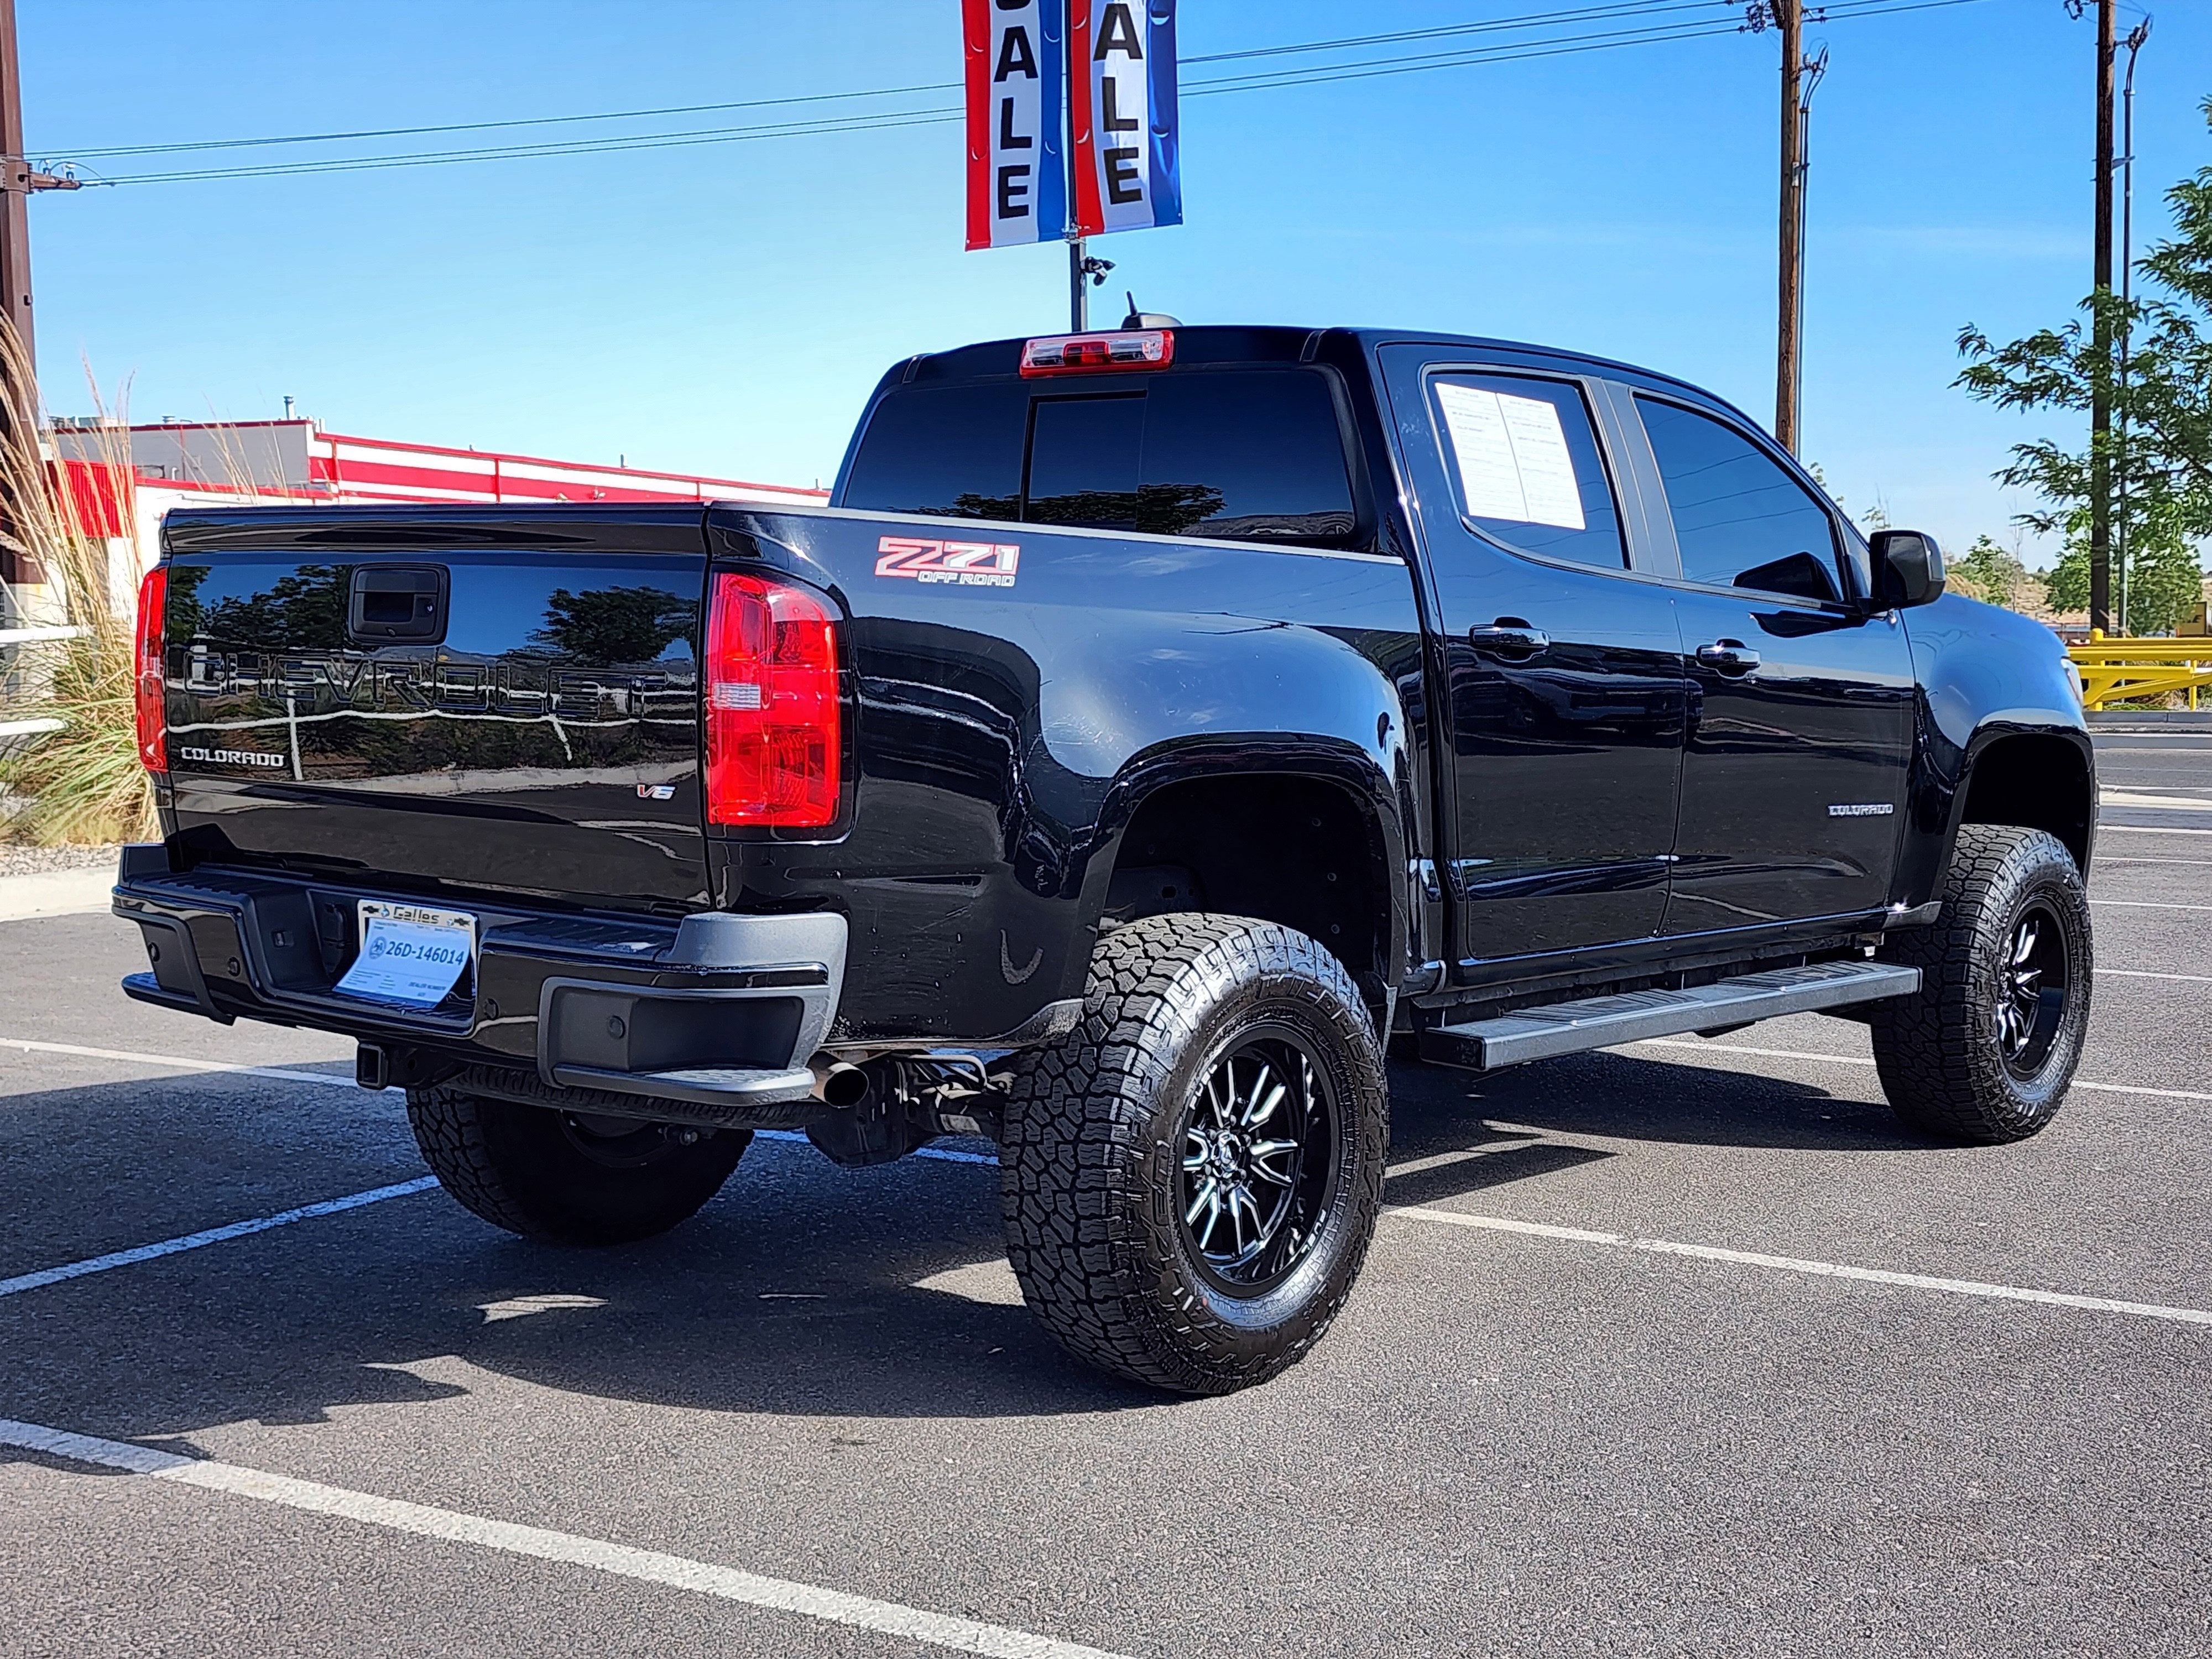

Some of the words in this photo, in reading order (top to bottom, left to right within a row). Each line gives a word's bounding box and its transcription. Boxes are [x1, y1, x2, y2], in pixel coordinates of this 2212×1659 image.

[994, 0, 1039, 220] ALE
[874, 536, 1020, 578] Z71
[918, 571, 958, 584] OFF
[959, 573, 1016, 587] ROAD
[183, 651, 668, 719] CHEVROLET
[181, 747, 285, 767] COLORADO
[637, 784, 676, 800] V6
[1828, 804, 1893, 816] COLORADO
[385, 941, 465, 966] 26D-146014
[1189, 1064, 1218, 1110] FUEL
